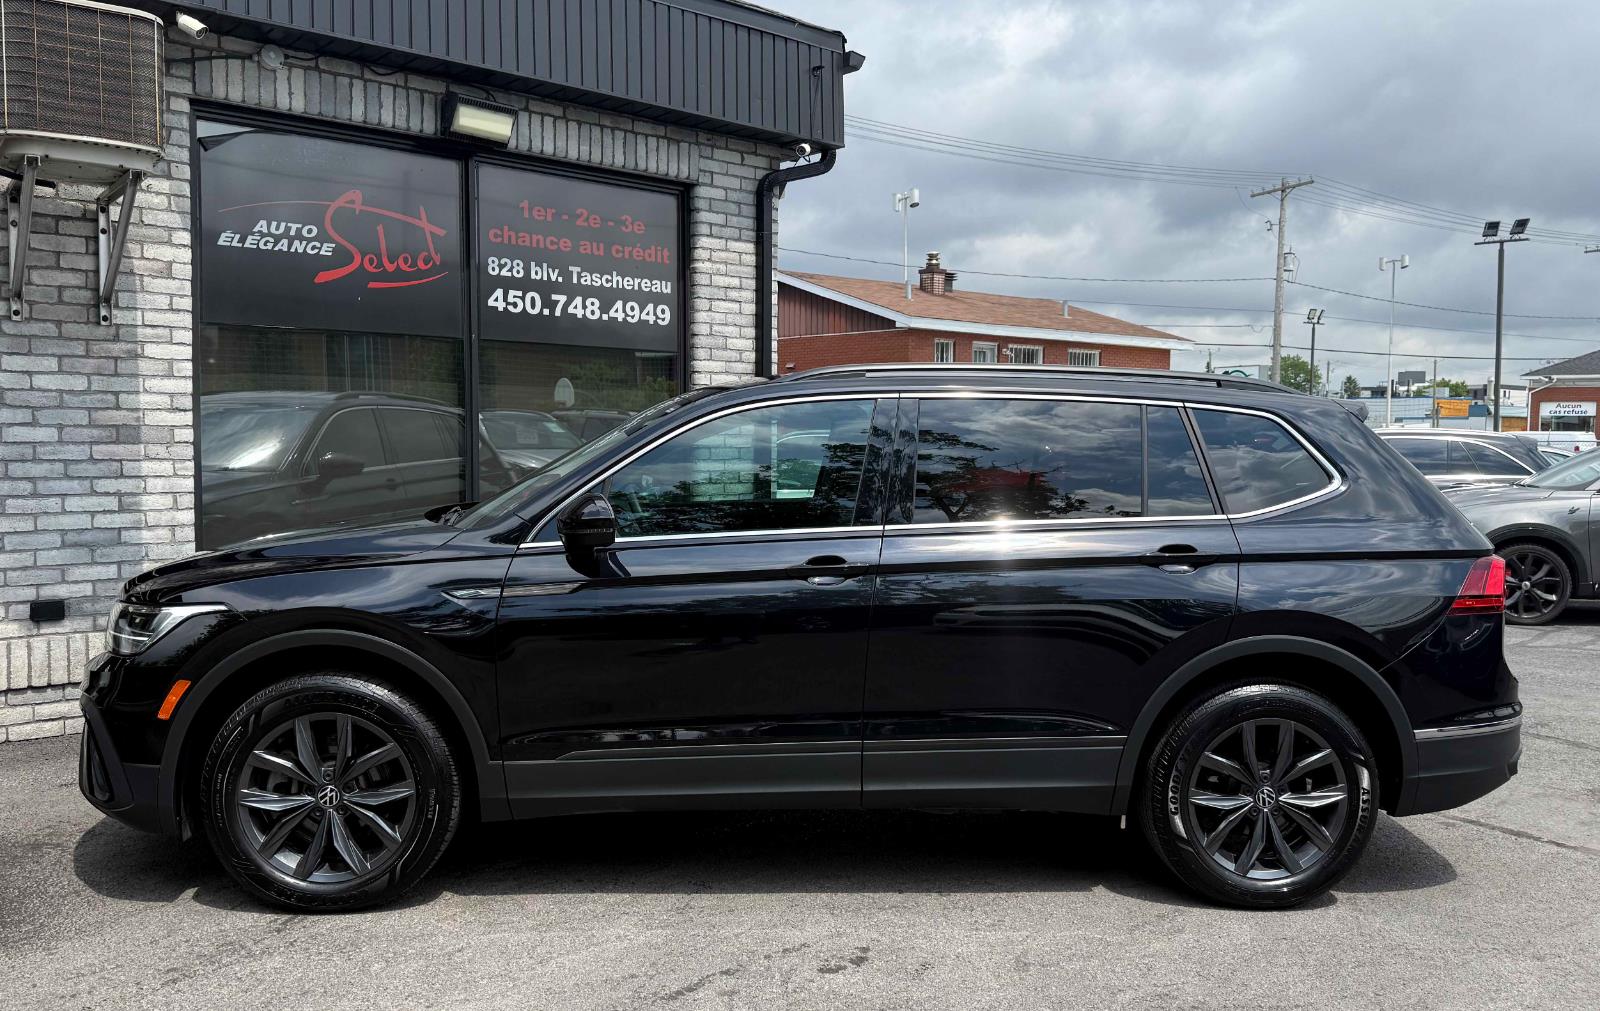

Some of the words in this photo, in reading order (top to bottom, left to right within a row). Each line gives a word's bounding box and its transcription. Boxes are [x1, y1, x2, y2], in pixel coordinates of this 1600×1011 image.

[252, 220, 318, 238] AUTO
[519, 199, 556, 222] 1er
[575, 207, 602, 229] 2e
[620, 214, 646, 234] 3e
[217, 231, 336, 257] ÉLÉGANCE
[313, 190, 447, 284] Select
[488, 225, 573, 252] chance
[579, 240, 605, 256] au
[611, 243, 670, 264] crédit
[487, 256, 524, 278] 828
[530, 261, 563, 283] blv.
[568, 265, 672, 294] Taschereau
[487, 288, 671, 326] 450.748.4949
